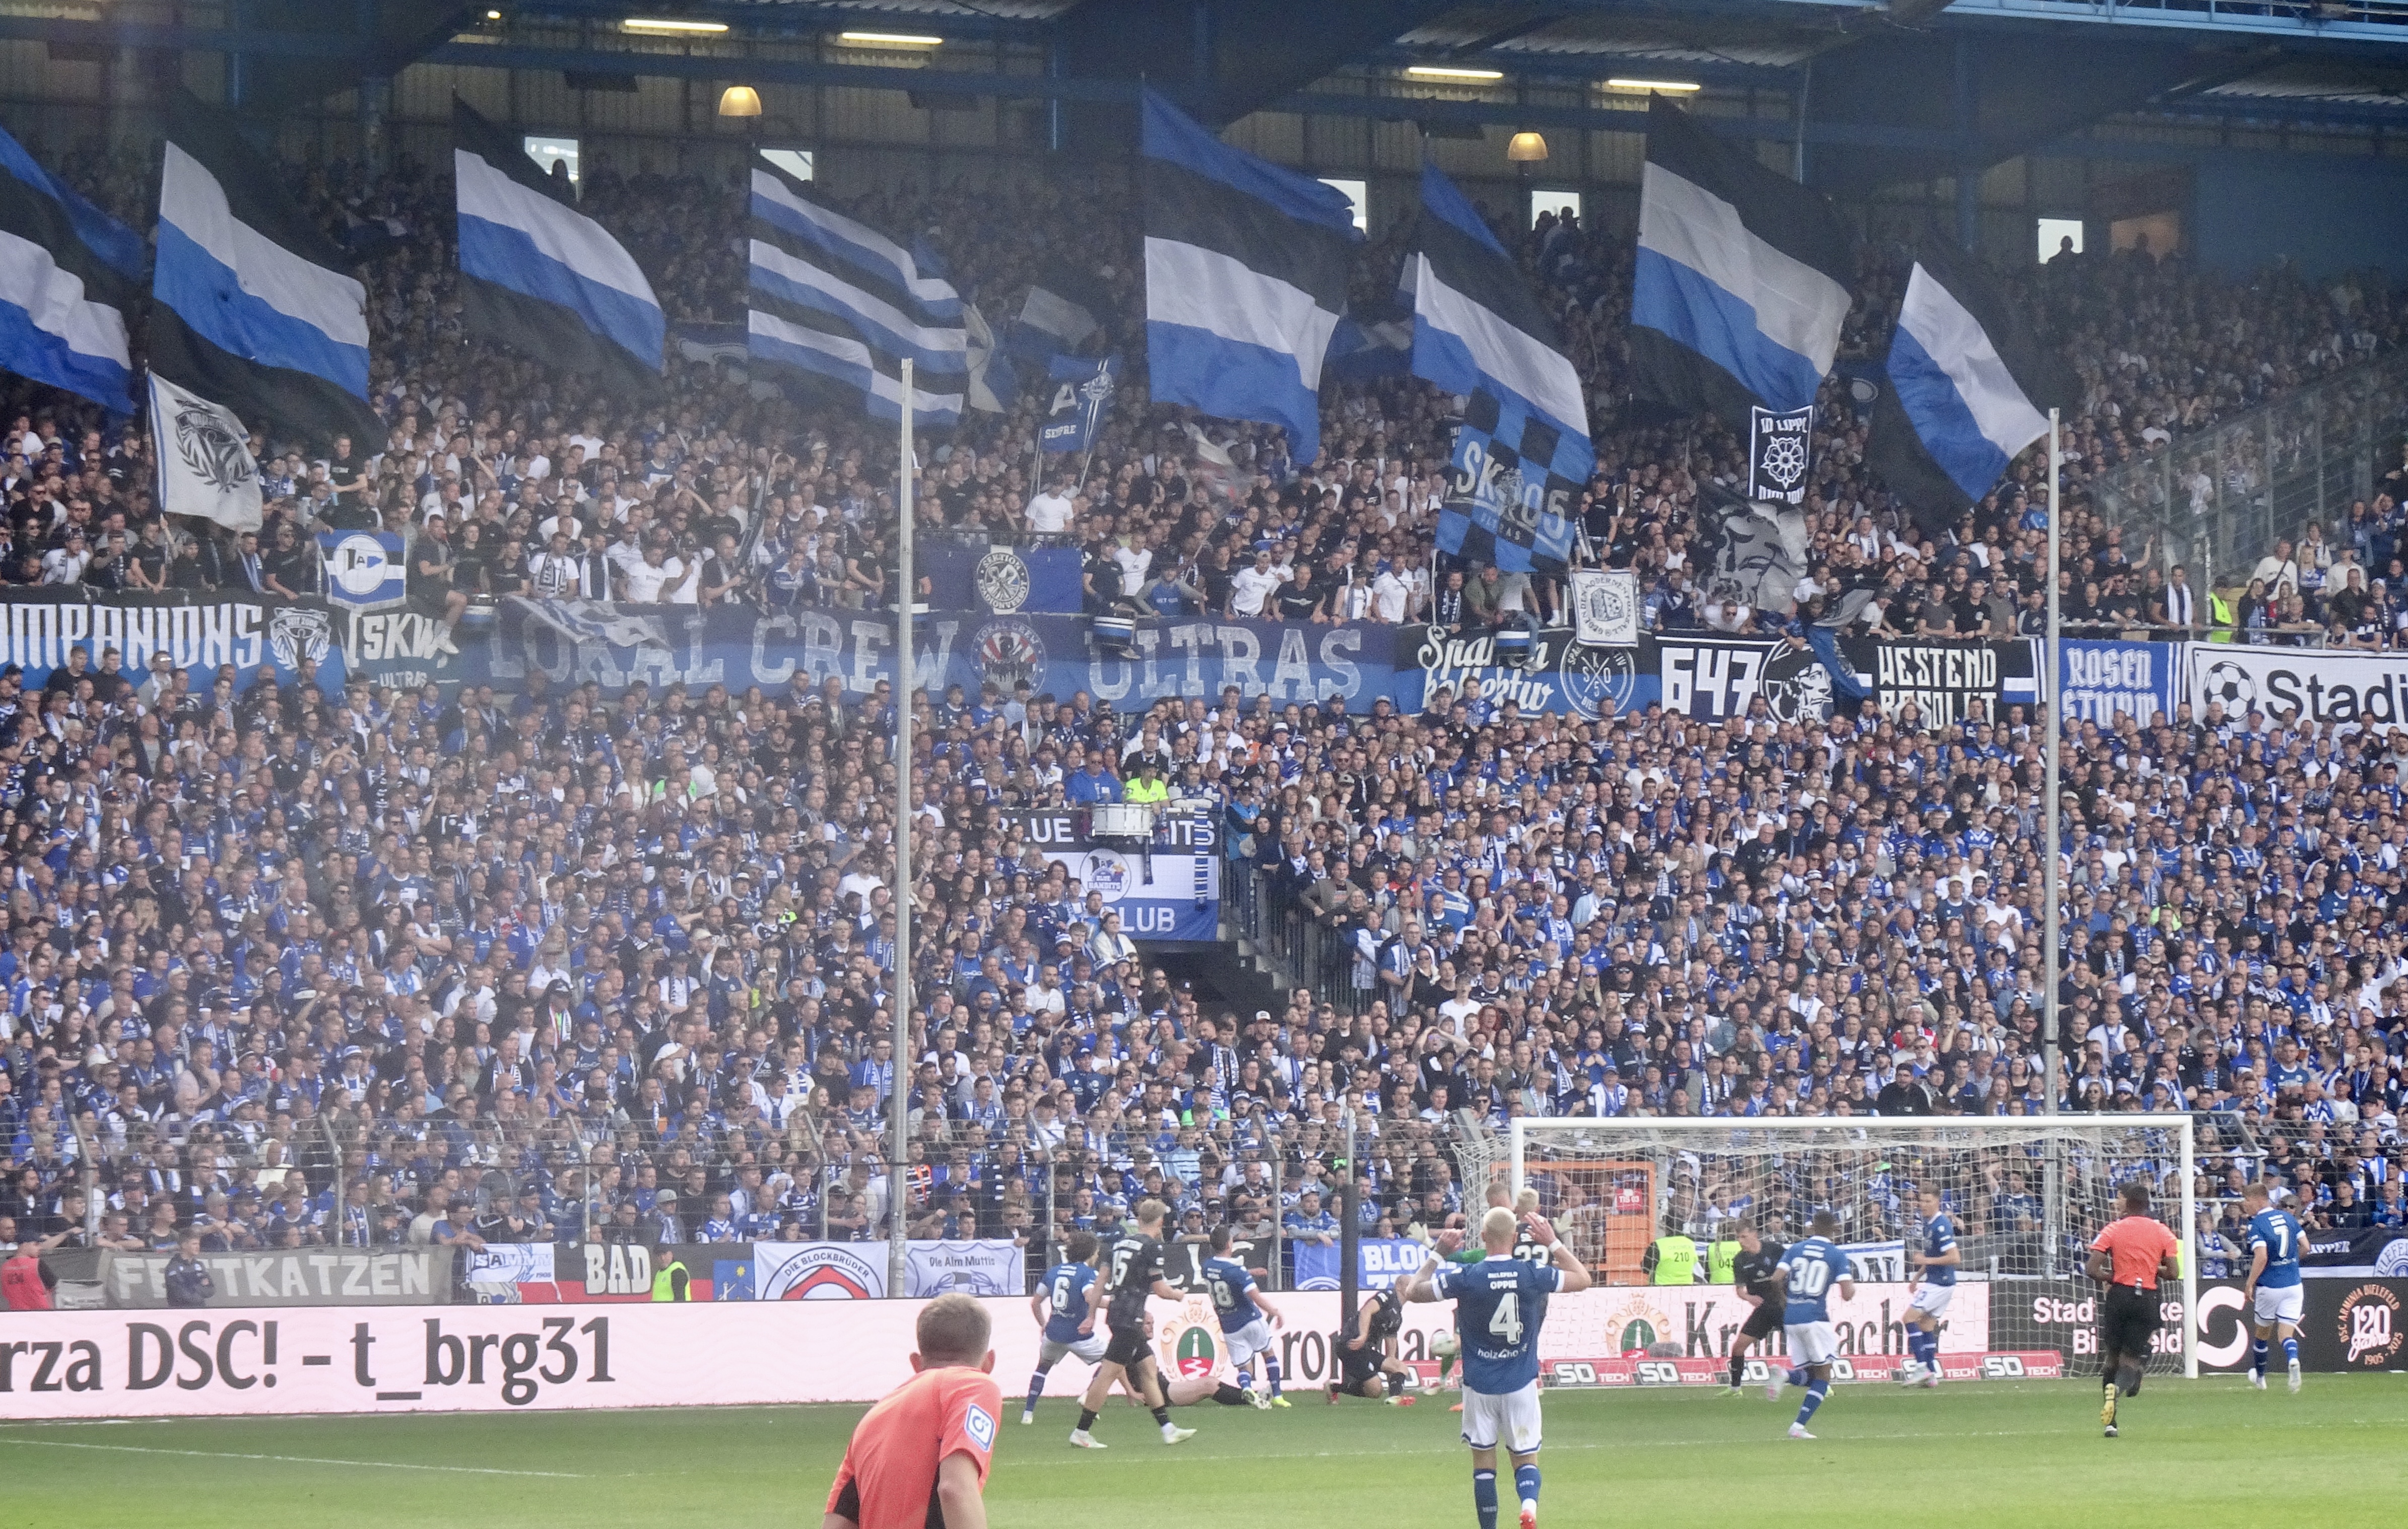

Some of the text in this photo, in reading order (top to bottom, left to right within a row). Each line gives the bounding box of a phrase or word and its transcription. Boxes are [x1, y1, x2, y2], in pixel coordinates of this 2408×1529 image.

[983, 555, 1021, 570] SEKTION
[0, 604, 262, 670] MPANIONS
[750, 611, 959, 693] CREW
[1084, 623, 1361, 701] ULTRAS
[1877, 646, 1996, 688] WESTEND
[2066, 648, 2153, 689] ROSEN
[1662, 647, 1760, 716] 647
[1118, 907, 1175, 932] LUB
[2273, 1225, 2289, 1258] 7
[584, 1244, 651, 1295] BAD
[784, 1252, 869, 1278] DIE BLOCKBRÜDER
[929, 1257, 942, 1267] Die
[964, 1256, 995, 1267] Muttis
[1674, 1252, 1690, 1263] 210
[113, 1254, 430, 1299] FETKATZEN
[1490, 1280, 1518, 1290] OPPIE
[1789, 1257, 1830, 1297] 30
[1052, 1276, 1070, 1310] 6
[2363, 1284, 2400, 1310] BIELEFELD
[1489, 1292, 1523, 1345] 4
[2351, 1304, 2391, 1336] 120
[0, 1340, 103, 1392] rza
[125, 1319, 278, 1390] DSC!
[350, 1316, 616, 1406] t_brg31
[1554, 1363, 1630, 1383] SO TECH
[1638, 1362, 1712, 1381] SO TECH
[1945, 1368, 1976, 1378] TECH
[1983, 1356, 2057, 1377] SO TECH
[2364, 1352, 2384, 1365] 1905
[1856, 1369, 1888, 1379] TECH
